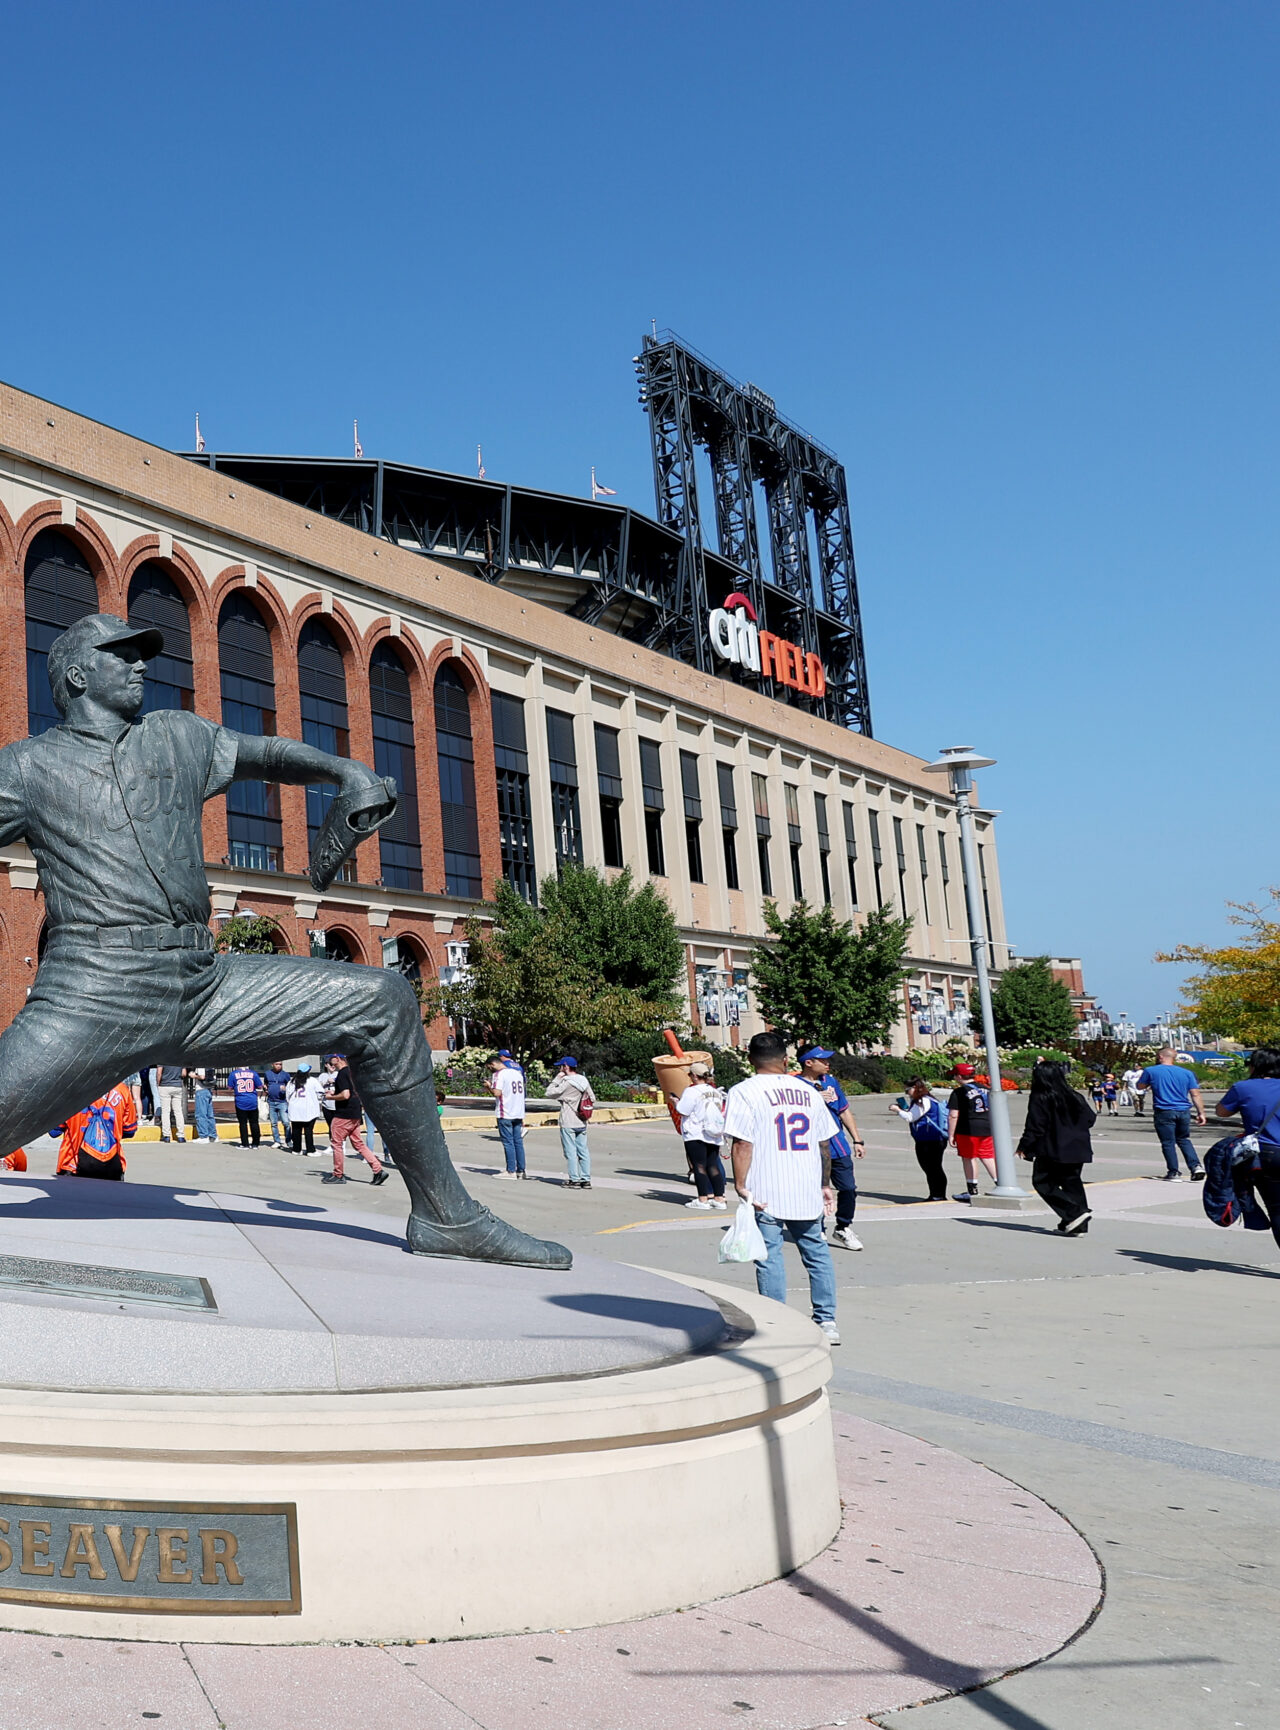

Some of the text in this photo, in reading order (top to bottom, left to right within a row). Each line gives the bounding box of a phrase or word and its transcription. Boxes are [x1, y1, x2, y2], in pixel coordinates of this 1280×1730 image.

[709, 607, 826, 697] citi FIELD
[237, 1079, 254, 1093] 20
[511, 1081, 523, 1094] 86
[764, 1088, 812, 1107] LINDOR
[774, 1112, 810, 1151] 12
